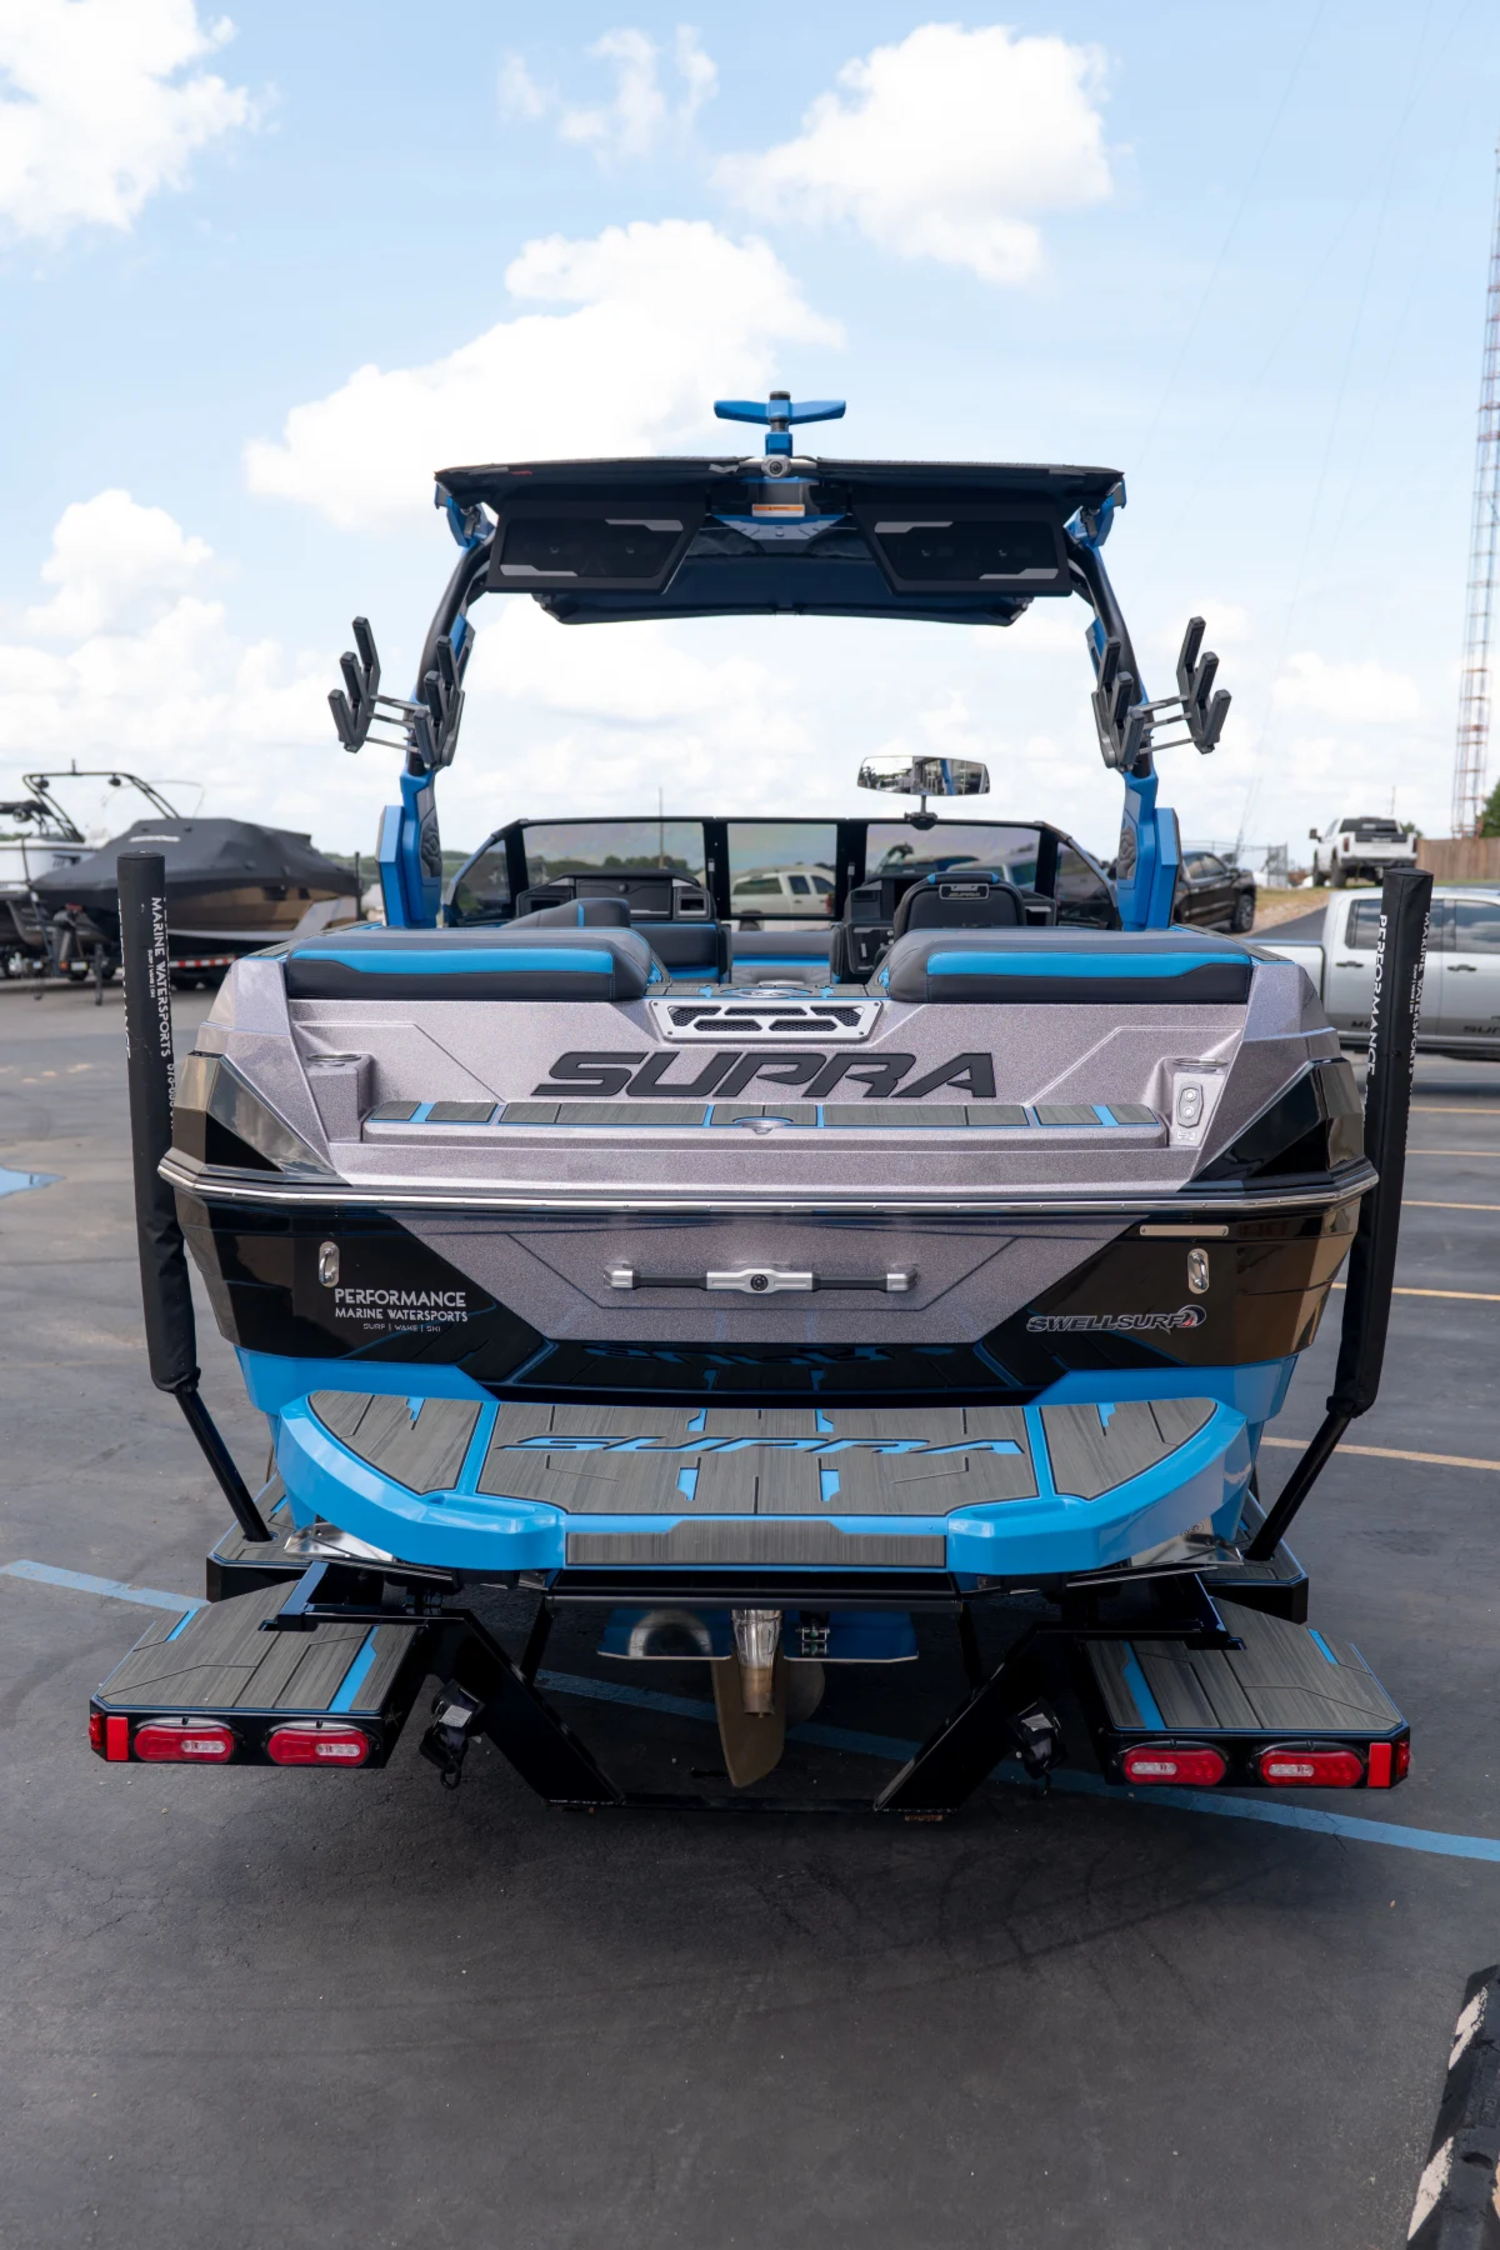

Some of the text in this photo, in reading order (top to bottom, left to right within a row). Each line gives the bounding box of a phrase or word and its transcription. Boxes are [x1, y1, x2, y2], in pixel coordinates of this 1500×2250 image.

[151, 897, 165, 957] MARINE
[155, 960, 171, 1058] WATERSPORTS
[1367, 914, 1388, 1076] PERFORMANCE
[530, 1050, 998, 1098] SUPRA
[334, 1288, 467, 1307] PERFORMANCE
[335, 1307, 469, 1322] MARINE WATERSPORTS
[363, 1323, 386, 1331] SURF
[493, 1435, 1026, 1454] SUPRA
